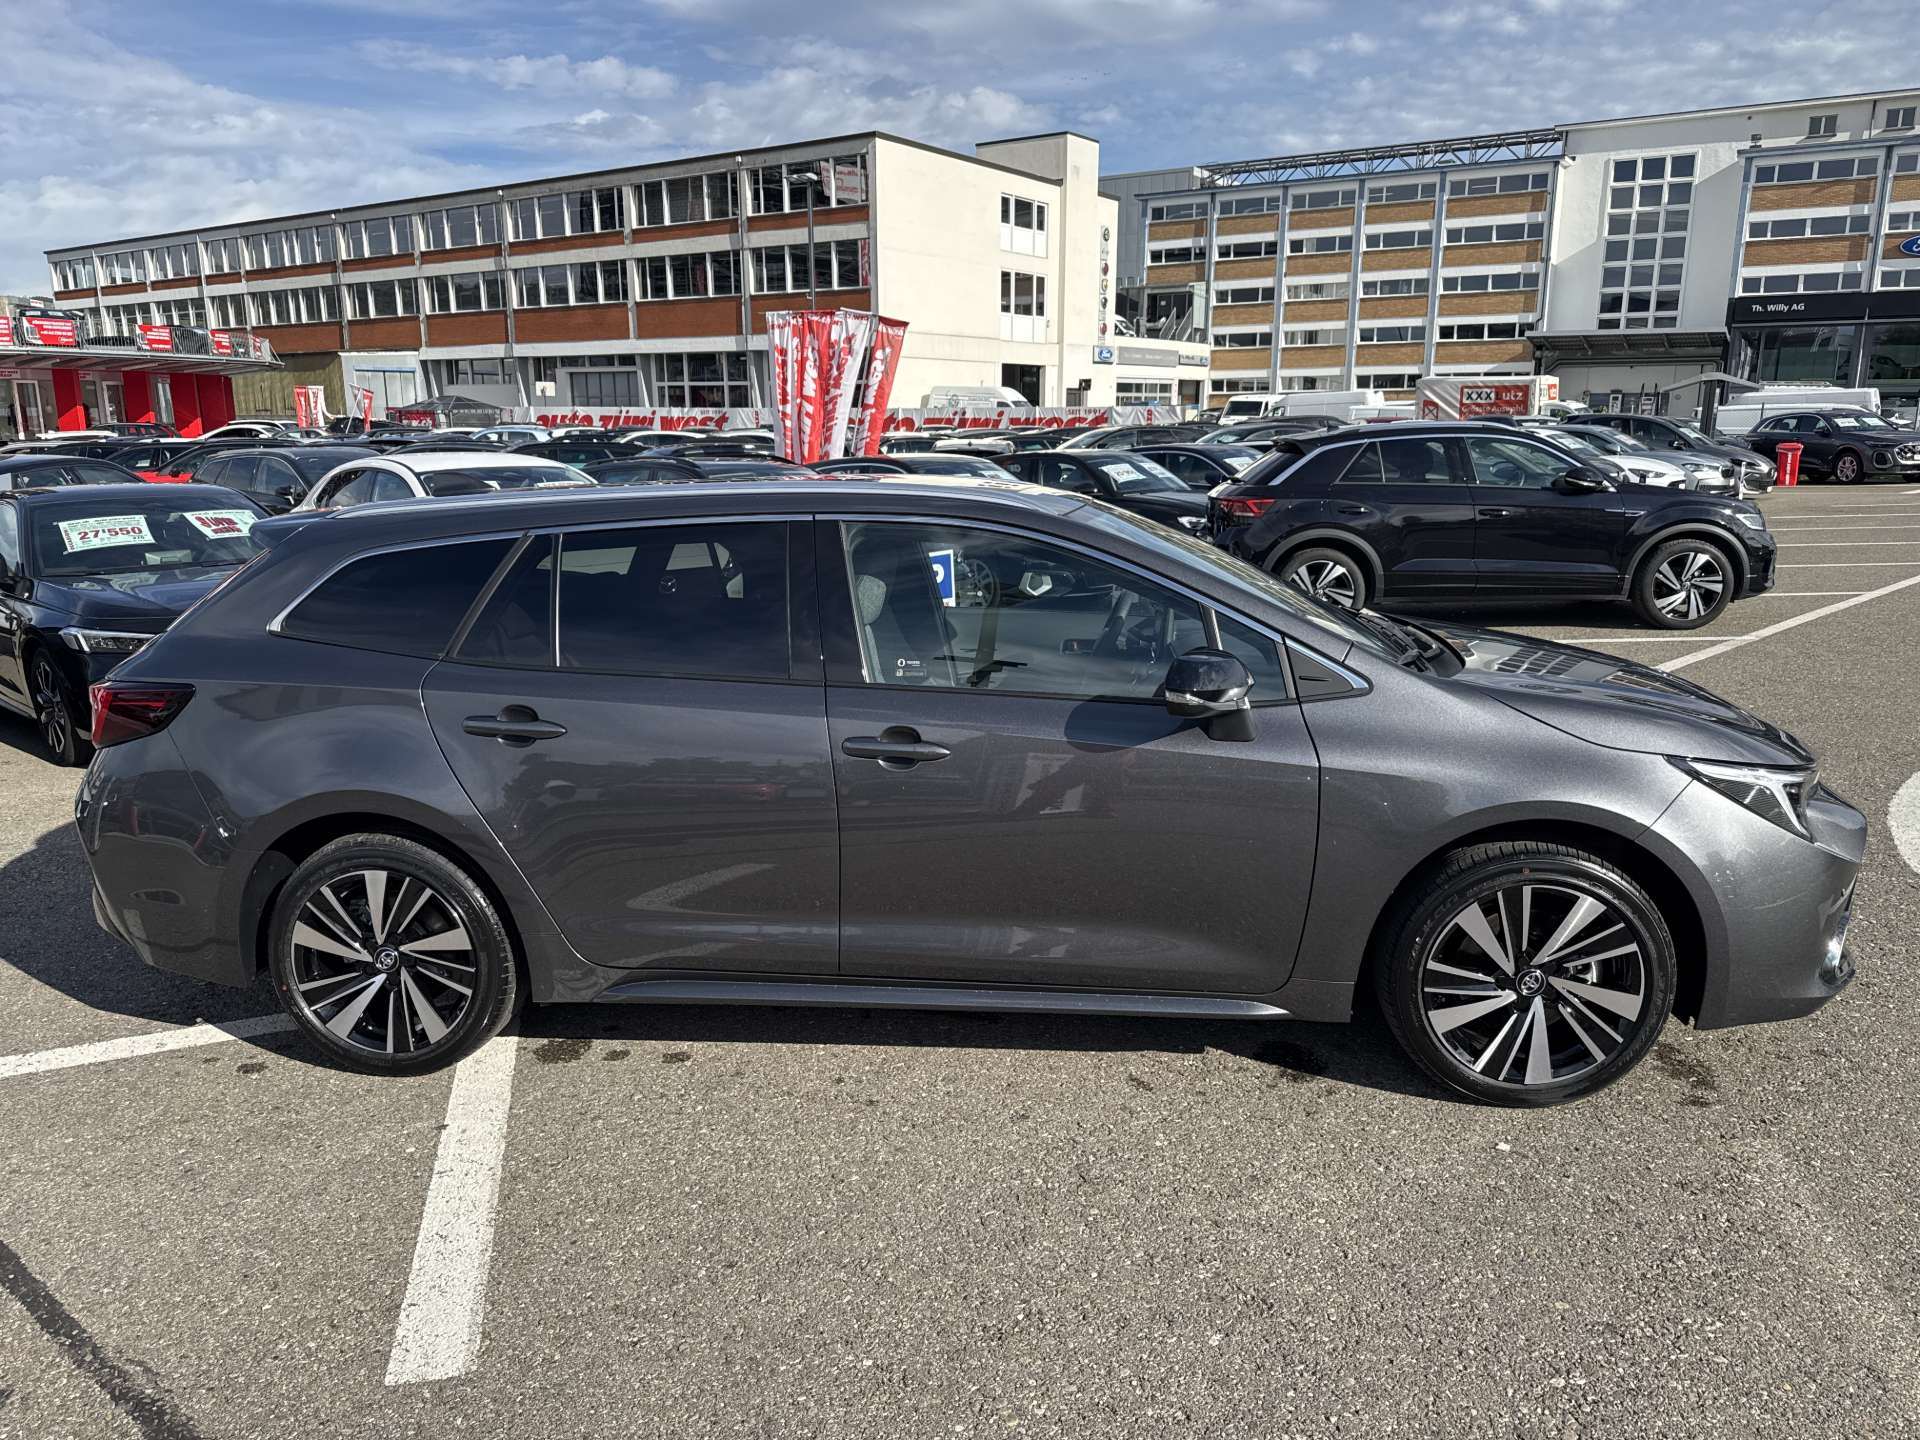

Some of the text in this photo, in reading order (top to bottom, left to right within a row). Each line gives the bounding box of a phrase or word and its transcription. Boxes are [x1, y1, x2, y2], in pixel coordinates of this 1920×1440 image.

[1752, 303, 1805, 313] Th. Willy AG
[77, 526, 143, 541] 27'550
